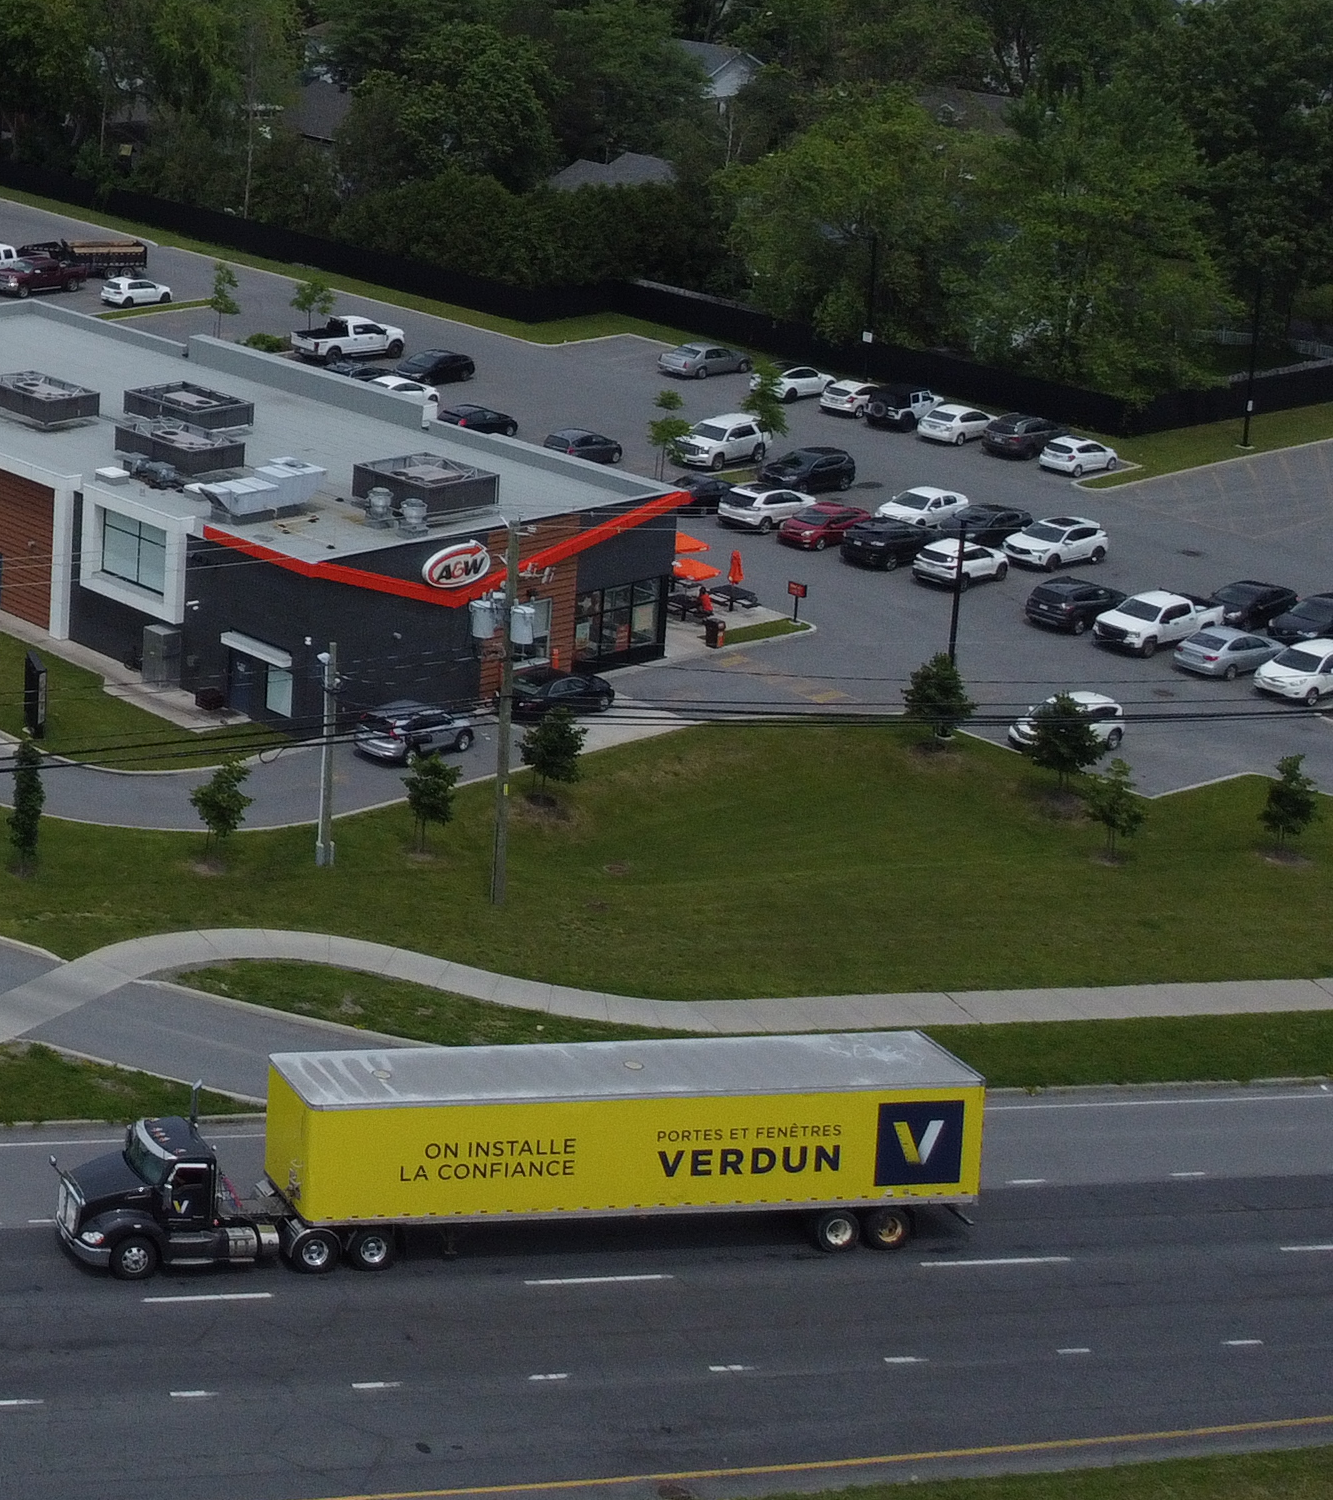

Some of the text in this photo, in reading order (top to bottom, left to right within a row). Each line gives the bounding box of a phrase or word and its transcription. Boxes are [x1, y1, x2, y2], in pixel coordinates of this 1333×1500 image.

[437, 556, 485, 582] A&W
[657, 1123, 842, 1143] PORTES ET FENÊTRES
[425, 1138, 577, 1160] ON INSTALLE
[400, 1160, 576, 1182] LA CONFIANCE
[657, 1144, 841, 1178] VERDUN
